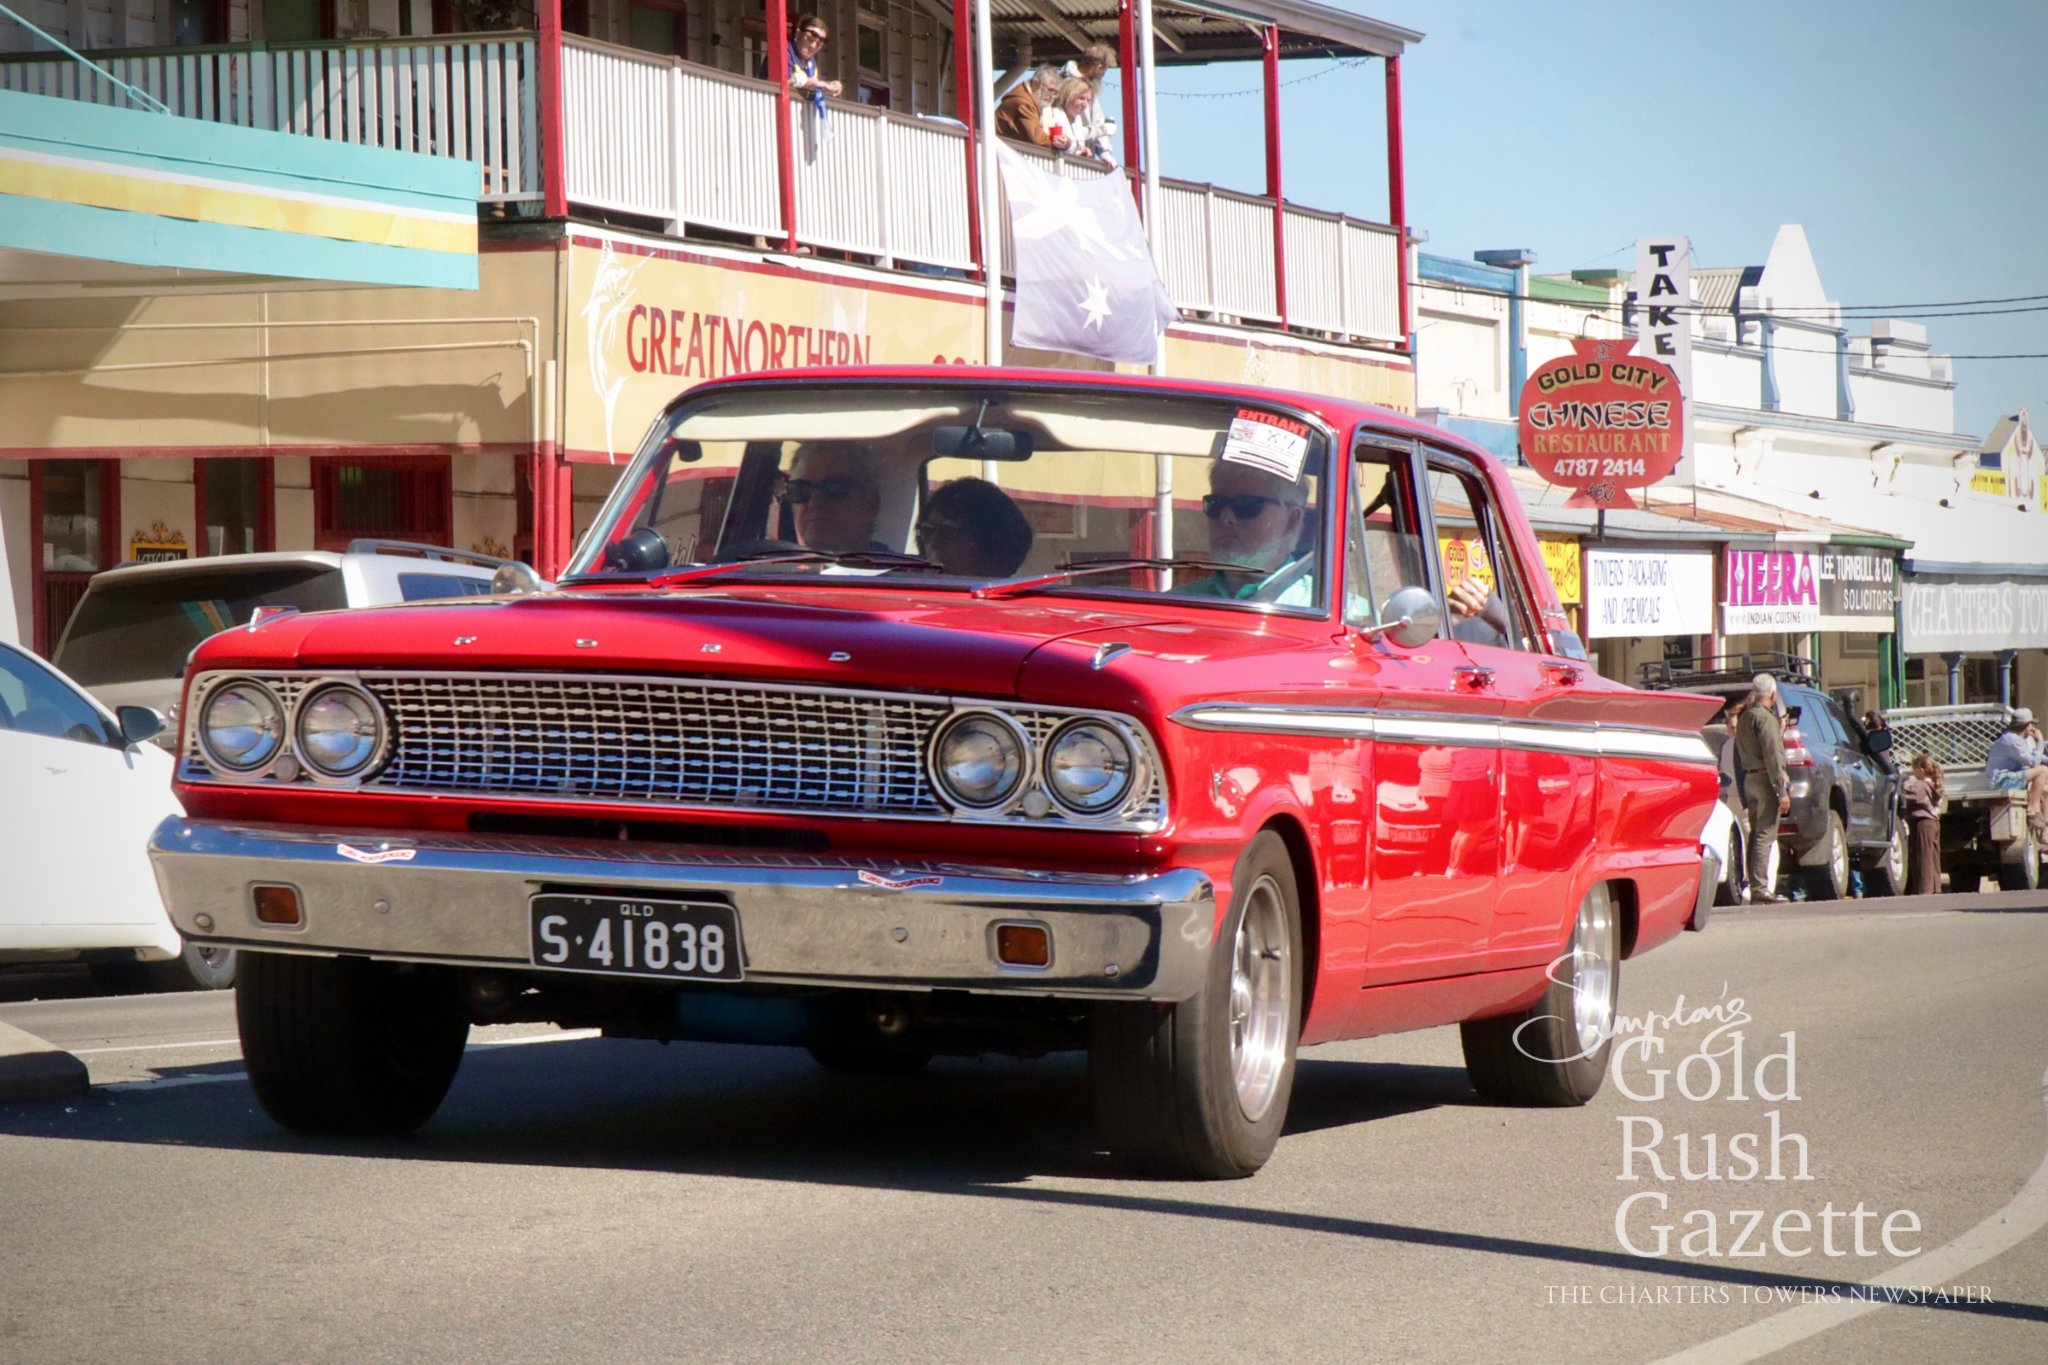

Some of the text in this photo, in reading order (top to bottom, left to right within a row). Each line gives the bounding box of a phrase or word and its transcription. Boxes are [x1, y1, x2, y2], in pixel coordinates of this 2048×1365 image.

[1649, 245, 1679, 355] TAKE
[1537, 362, 1669, 395] GOLD CITY
[1237, 409, 1308, 437] ENTRANT
[1527, 400, 1672, 432] CHINESE
[1533, 433, 1671, 454] RESTAURANT
[1553, 458, 1646, 477] 4787 2414
[1594, 559, 1624, 587] TOWERS
[1628, 559, 1668, 588] PACKAGING
[1729, 550, 1818, 606] HEERA
[1836, 555, 1874, 582] TURNBULL
[1874, 559, 1881, 581] &
[1881, 558, 1893, 583] CO
[1602, 597, 1661, 625] AND CHEMICALS
[1843, 588, 1893, 611] SOLICITORS
[1908, 584, 2014, 637] CHARTERS
[1747, 611, 1801, 625] INDIAN CUISINE
[619, 904, 654, 917] QLD
